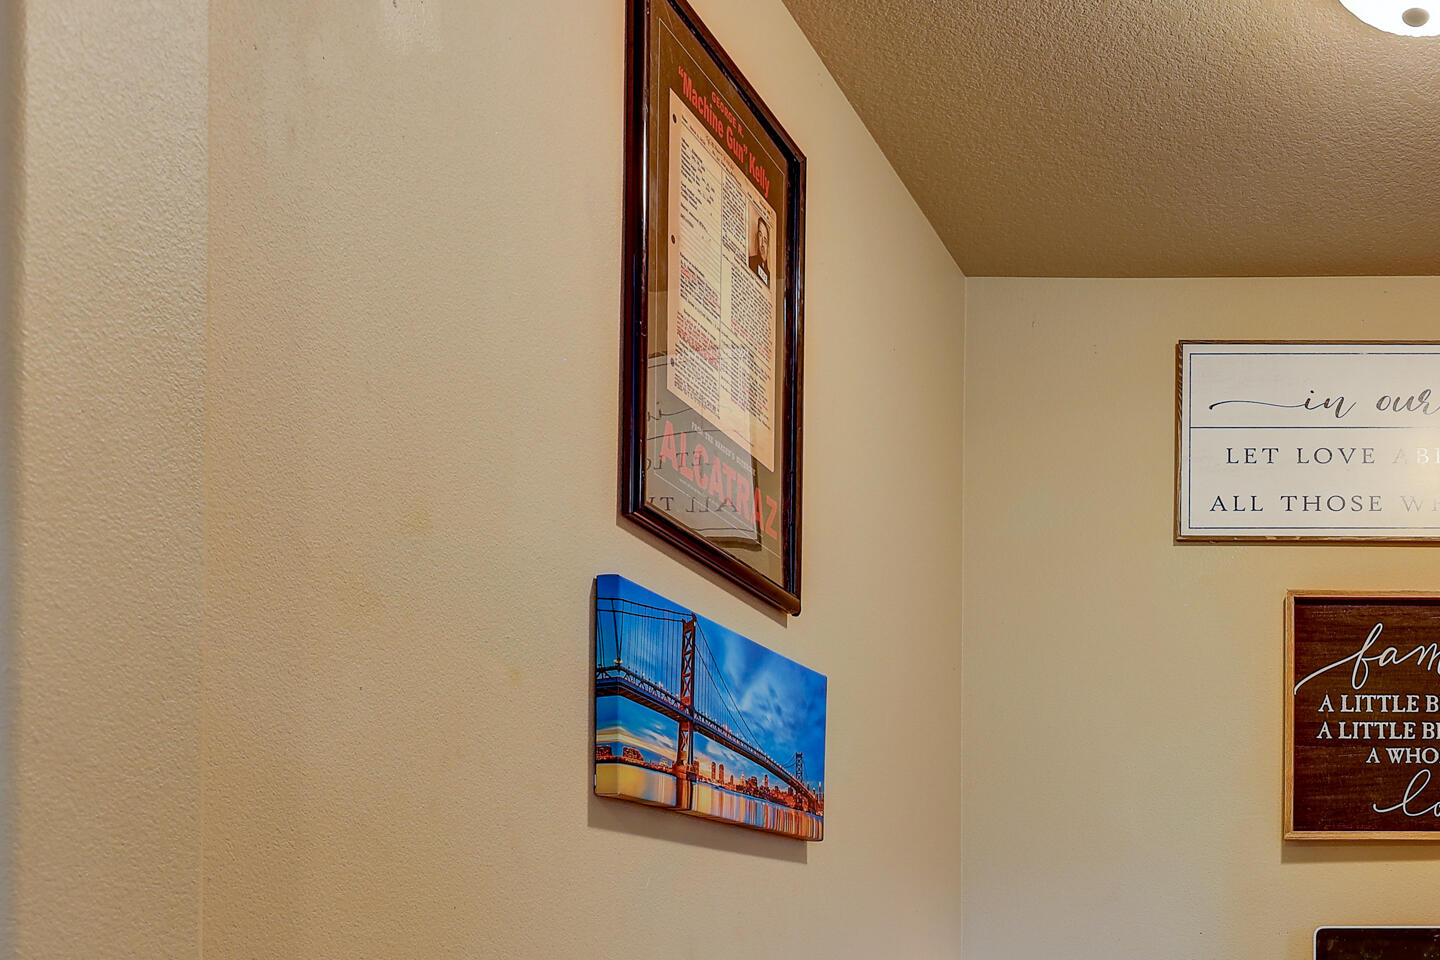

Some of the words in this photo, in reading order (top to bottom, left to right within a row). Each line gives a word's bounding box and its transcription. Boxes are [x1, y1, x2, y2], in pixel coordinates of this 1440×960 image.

[711, 91, 736, 128] GEORGE
[678, 65, 724, 138] “Machine
[726, 125, 748, 164] Gun”
[749, 152, 770, 199] Kelly
[1225, 447, 1280, 465] LET
[1296, 447, 1377, 465] LOVE
[658, 419, 779, 541] ALCATRAZ
[1209, 494, 1264, 512] ALL
[1280, 494, 1383, 513] THOSE
[1318, 694, 1335, 713] A
[1340, 694, 1419, 713] LITTLE
[1316, 722, 1333, 740] A
[1338, 722, 1416, 740] LITTLE
[1366, 748, 1381, 764] A
